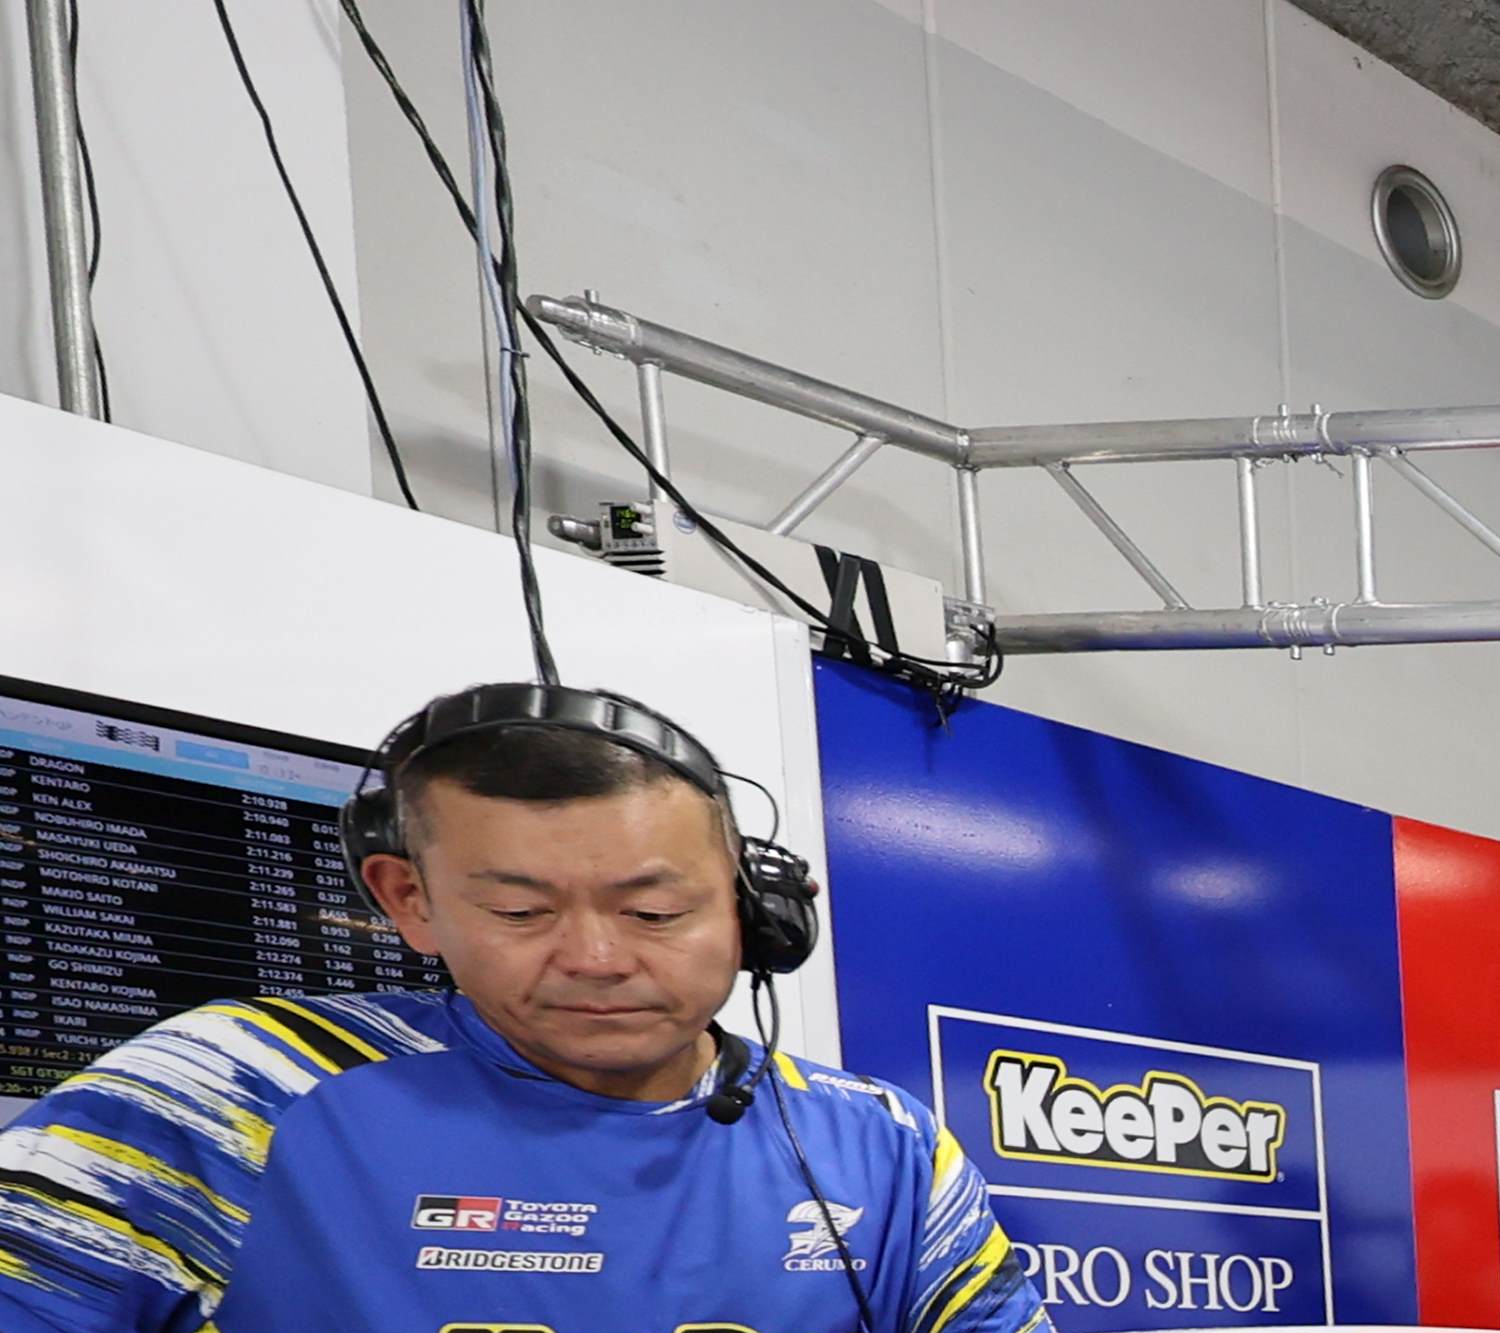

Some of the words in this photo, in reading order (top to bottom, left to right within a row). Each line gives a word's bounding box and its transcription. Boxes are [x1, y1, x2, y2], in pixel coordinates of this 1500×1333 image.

[29, 755, 86, 775] DRAGON
[30, 774, 92, 793] KENTARO
[32, 792, 60, 807] KEN
[61, 794, 93, 812] ALEX
[34, 811, 105, 832] NOBUHIRO
[105, 820, 148, 839] IMADA
[103, 839, 138, 855] UEDA
[42, 903, 98, 921] WILLIAM
[99, 911, 136, 926] SAKAI
[47, 959, 69, 971] GO
[50, 977, 110, 994] KENTARO
[992, 1056, 1283, 1176] KeePer
[505, 1198, 598, 1214] TOYOTA
[415, 1205, 496, 1230] GR
[503, 1211, 590, 1225] GAZOO
[420, 1249, 602, 1272] BRIDGESTONE
[1012, 1241, 1132, 1309] PRO
[1144, 1249, 1295, 1313] SHOP
